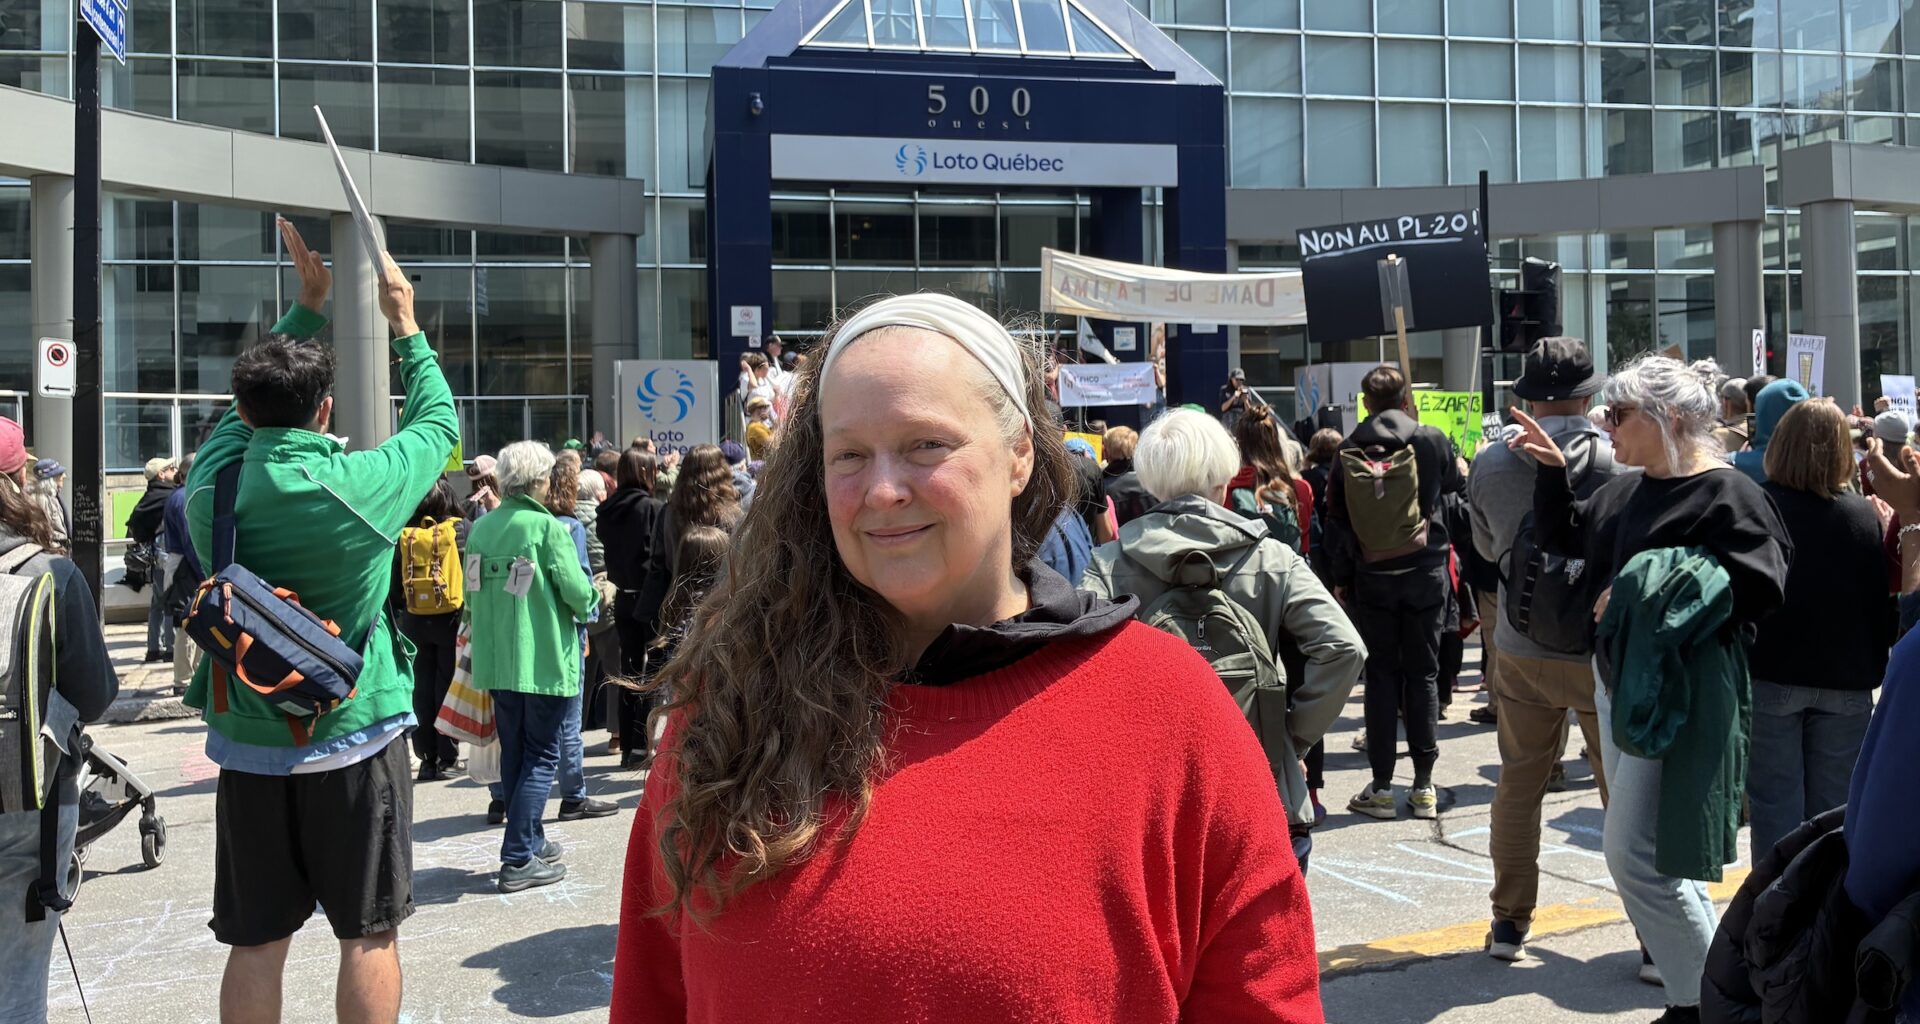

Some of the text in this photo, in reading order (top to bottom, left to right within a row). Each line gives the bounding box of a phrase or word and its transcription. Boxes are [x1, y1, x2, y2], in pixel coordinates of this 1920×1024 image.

[928, 85, 1031, 117] 500
[928, 119, 1031, 130] ouest
[934, 151, 1064, 172] Loto Québec
[1298, 207, 1480, 256] NON AU PL-20!
[650, 429, 684, 442] Loto
